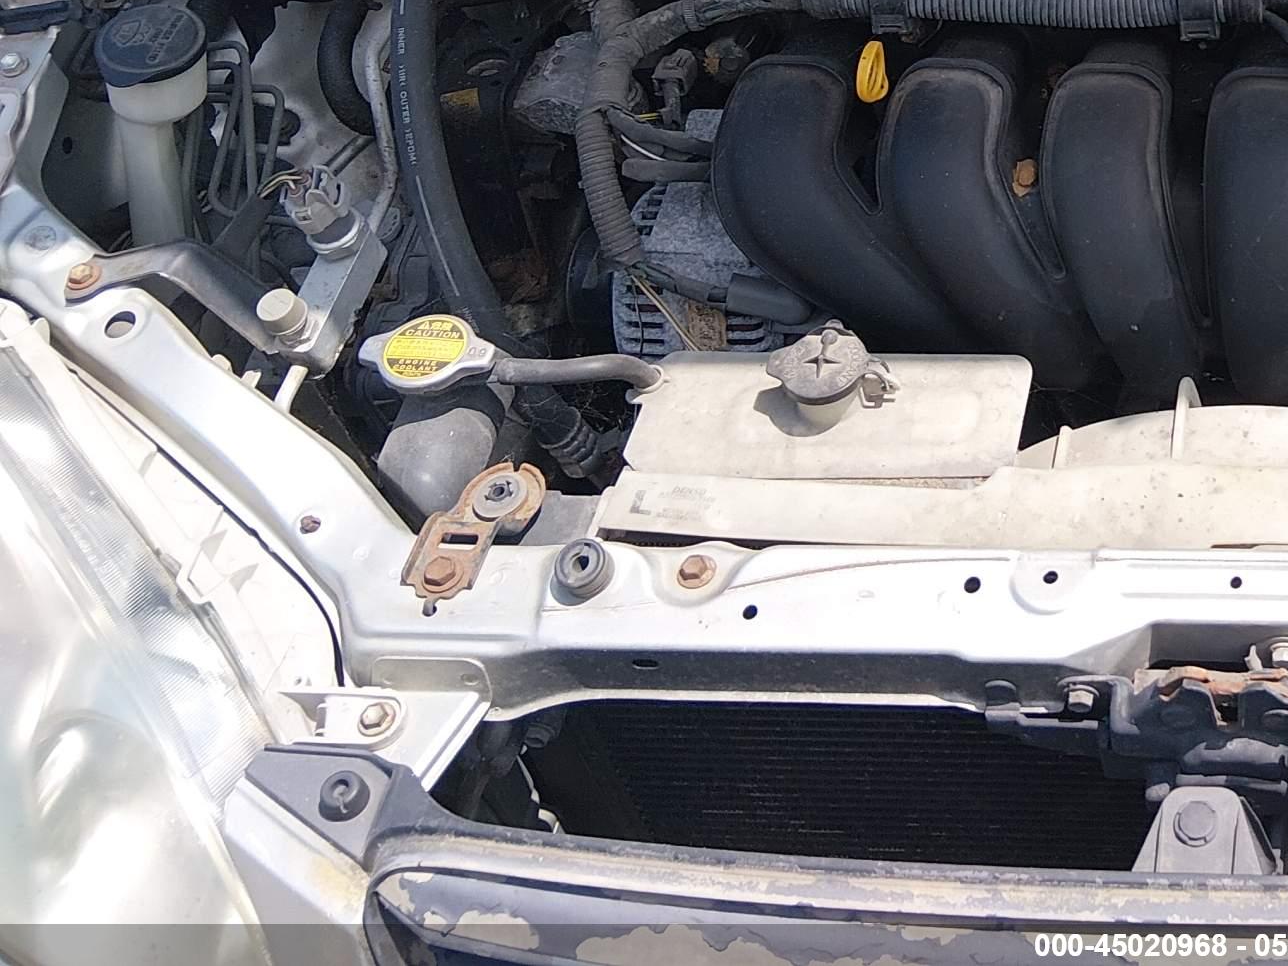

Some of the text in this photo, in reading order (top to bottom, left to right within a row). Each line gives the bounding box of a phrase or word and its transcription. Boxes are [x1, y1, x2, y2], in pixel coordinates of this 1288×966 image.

[400, 90, 411, 124] OUTER
[405, 329, 461, 338] CAUTION
[398, 358, 437, 366] ENGINE
[393, 364, 438, 372] COOLANT
